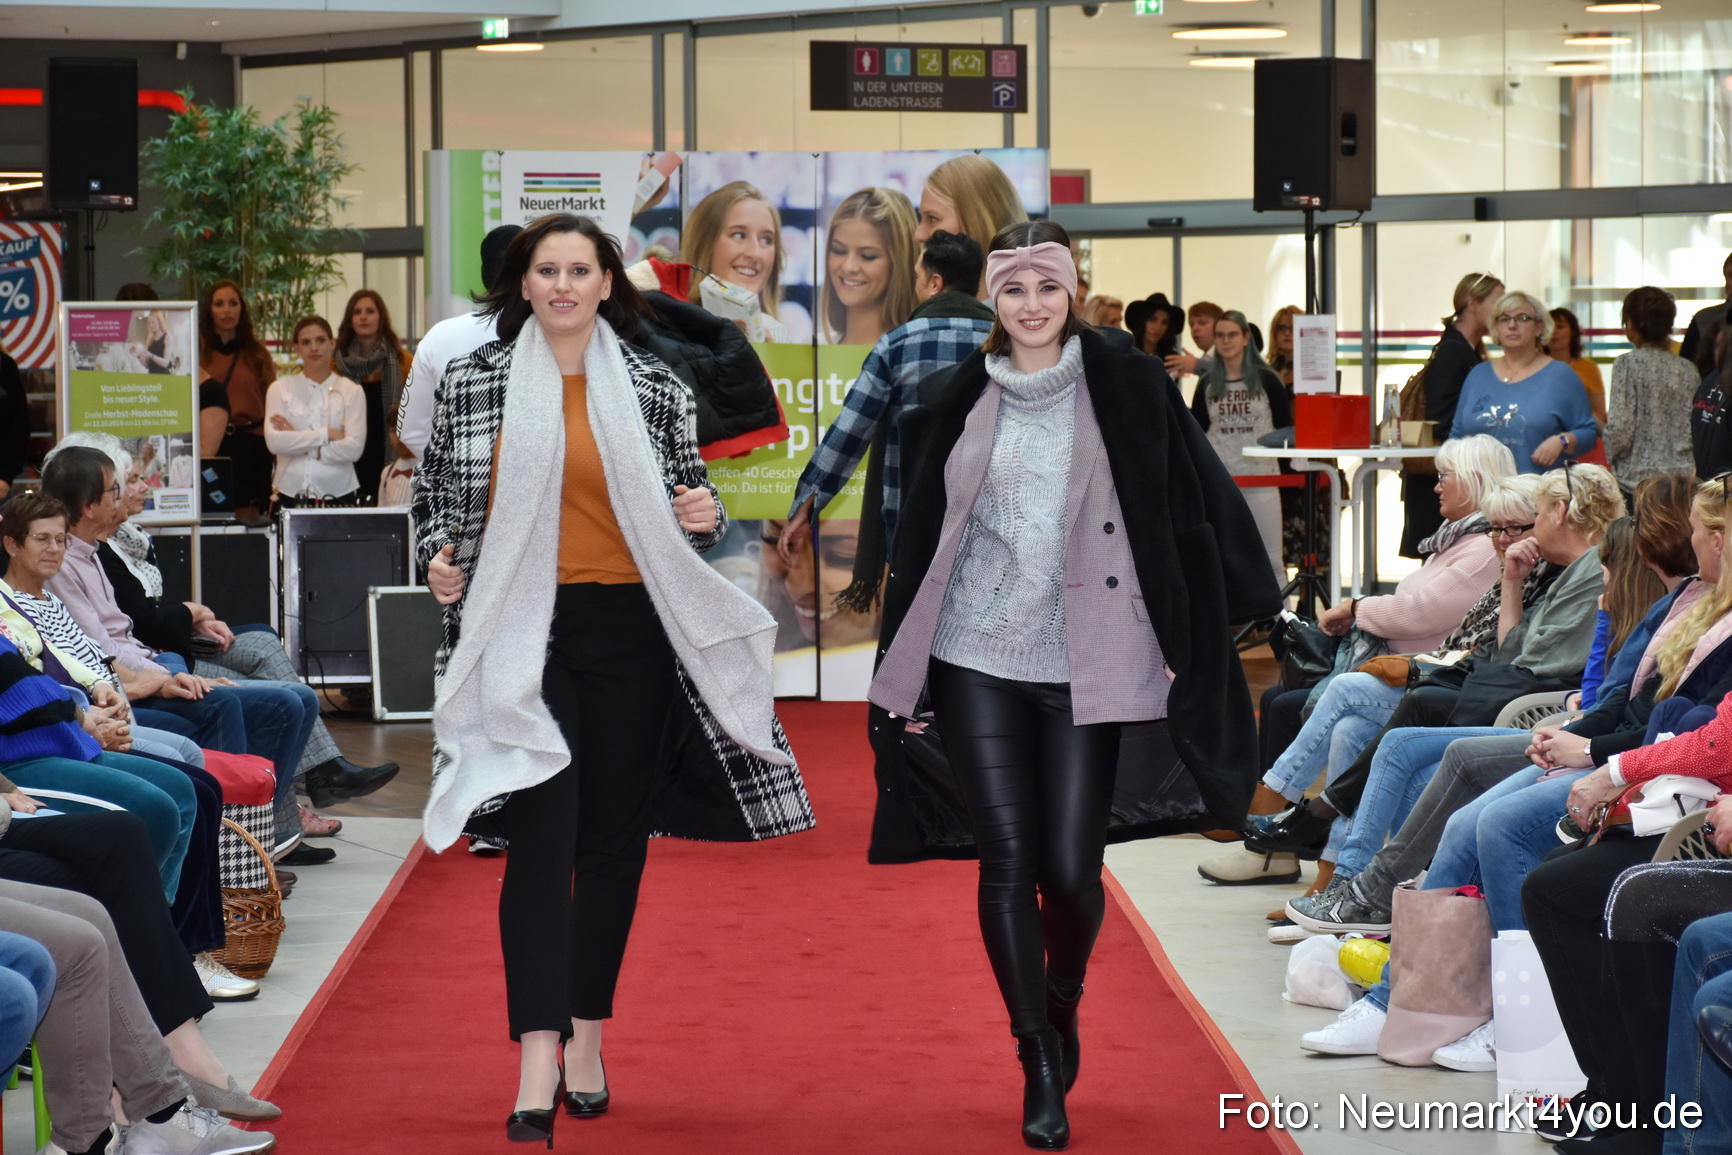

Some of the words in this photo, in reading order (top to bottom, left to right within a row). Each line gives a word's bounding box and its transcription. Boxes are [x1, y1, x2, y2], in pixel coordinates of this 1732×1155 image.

[853, 82, 864, 93] IN
[867, 82, 887, 93] DER
[891, 82, 944, 93] UNTEREN
[853, 96, 944, 109] LADENSTRASSE
[519, 196, 606, 211] NeuerMarkt
[100, 384, 115, 392] Von
[103, 395, 114, 404] bis
[1218, 403, 1251, 416] STATE
[742, 467, 759, 478] 40
[761, 467, 805, 479] Geschä
[742, 482, 757, 493] Da
[760, 482, 774, 493] ist
[776, 482, 792, 493] für
